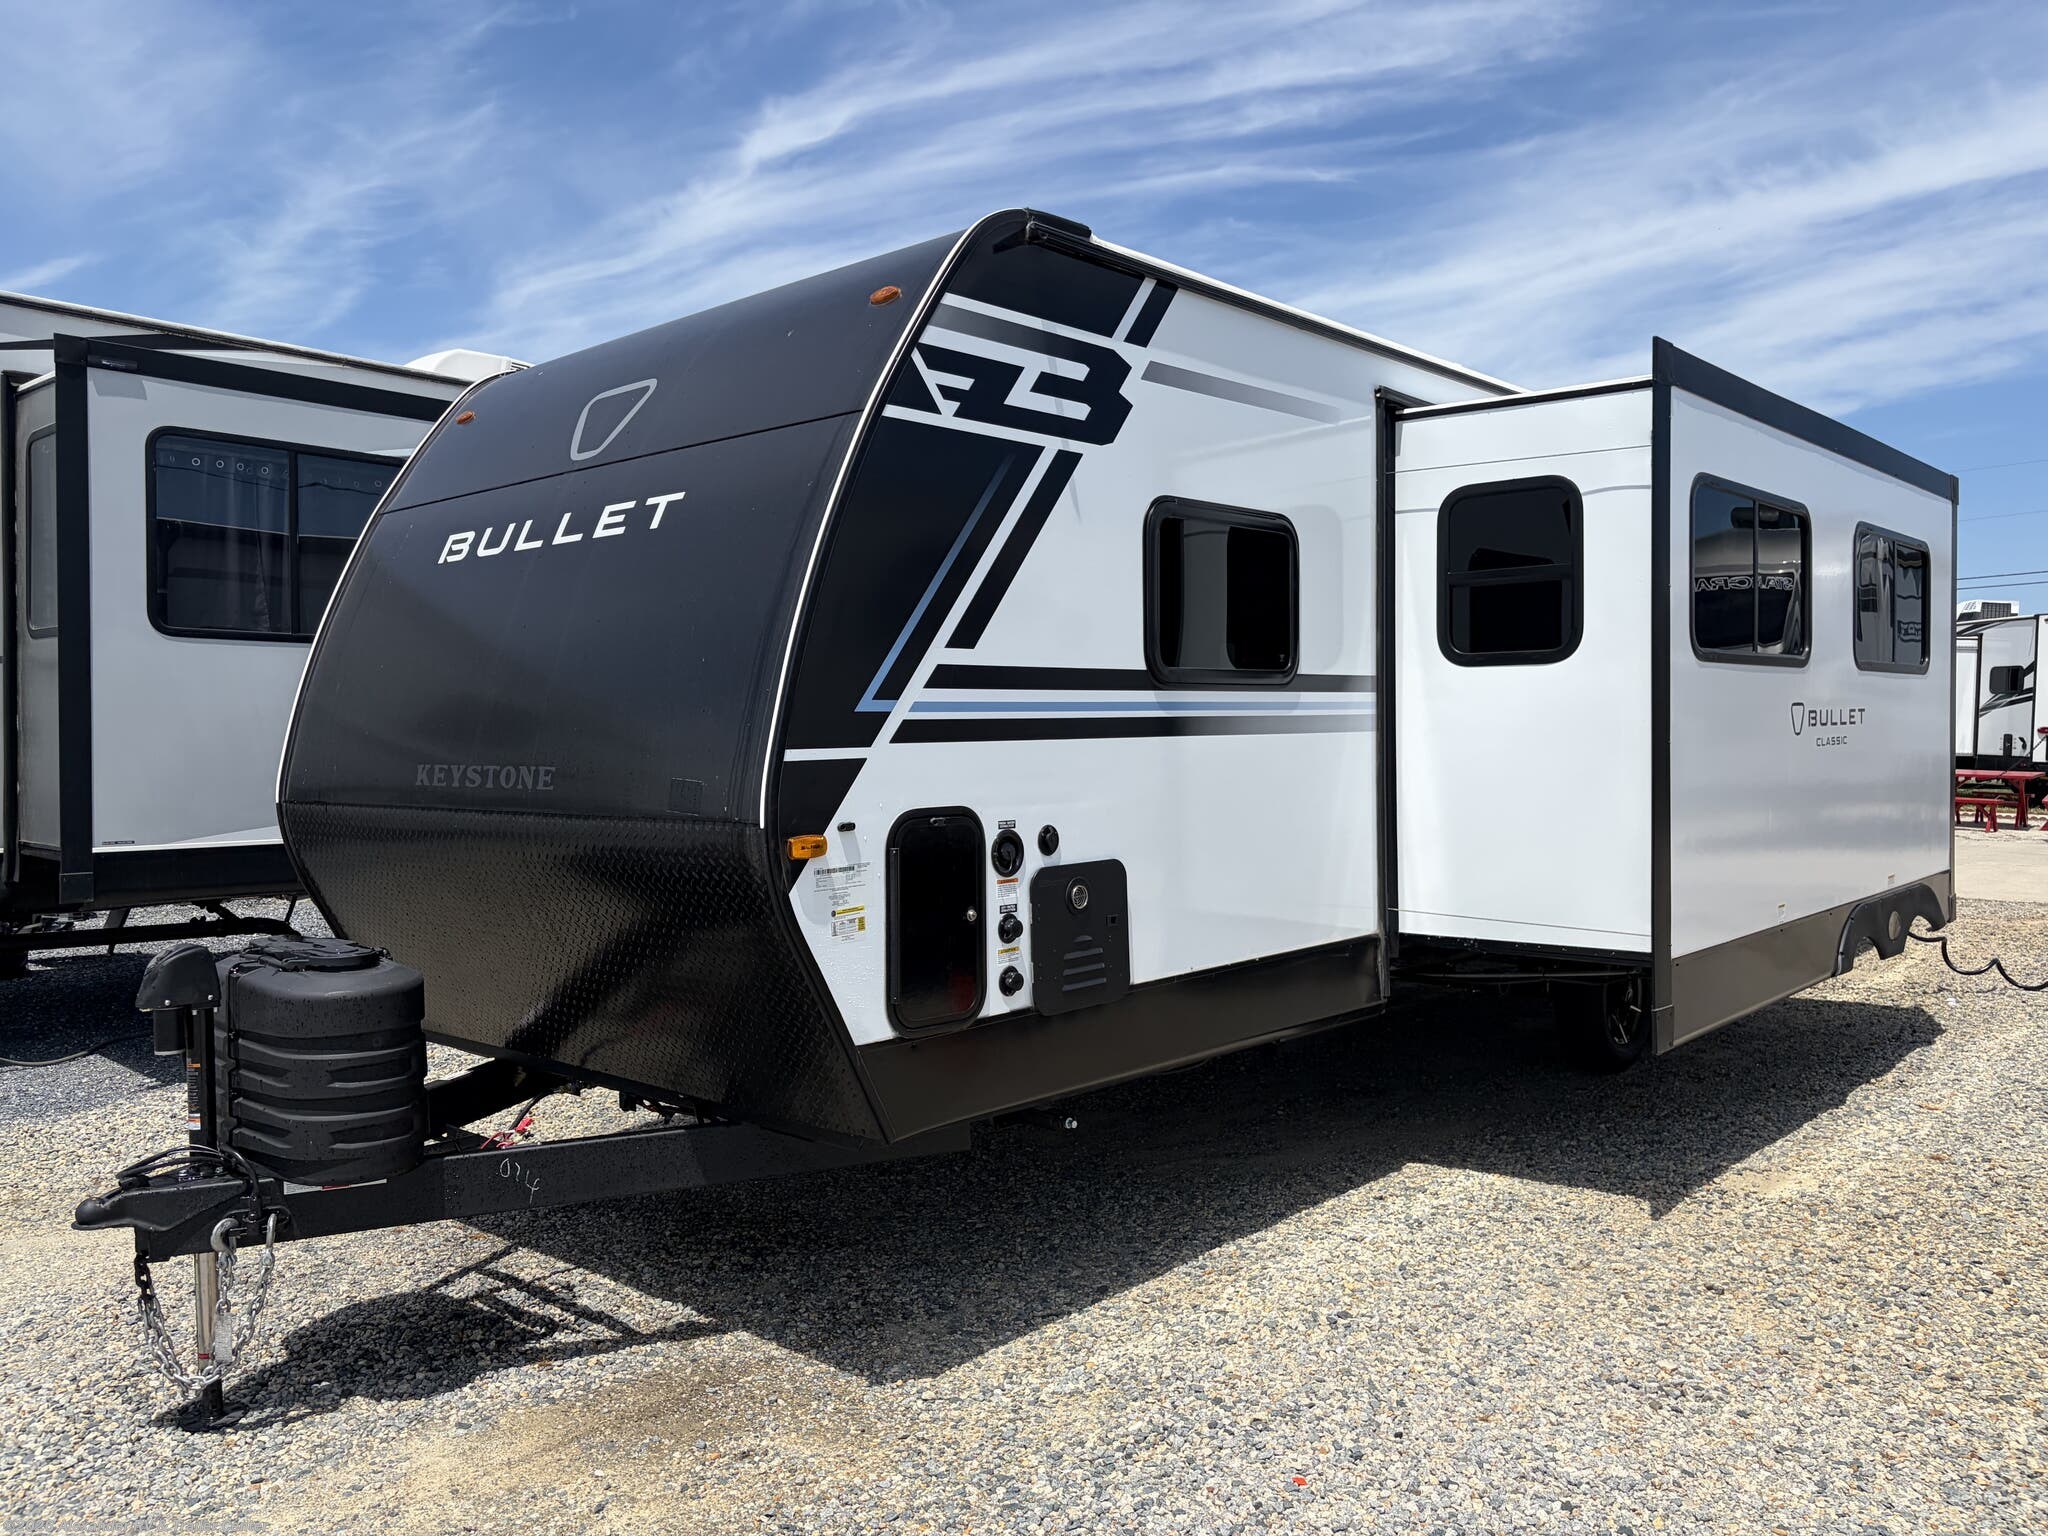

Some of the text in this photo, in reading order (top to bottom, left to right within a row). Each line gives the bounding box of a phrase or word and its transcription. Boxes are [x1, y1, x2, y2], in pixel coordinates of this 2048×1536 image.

[437, 491, 686, 565] BULLET
[1808, 708, 1866, 727] BULLET
[1815, 735, 1848, 747] CLASSIC
[415, 764, 556, 790] KEYSTONE
